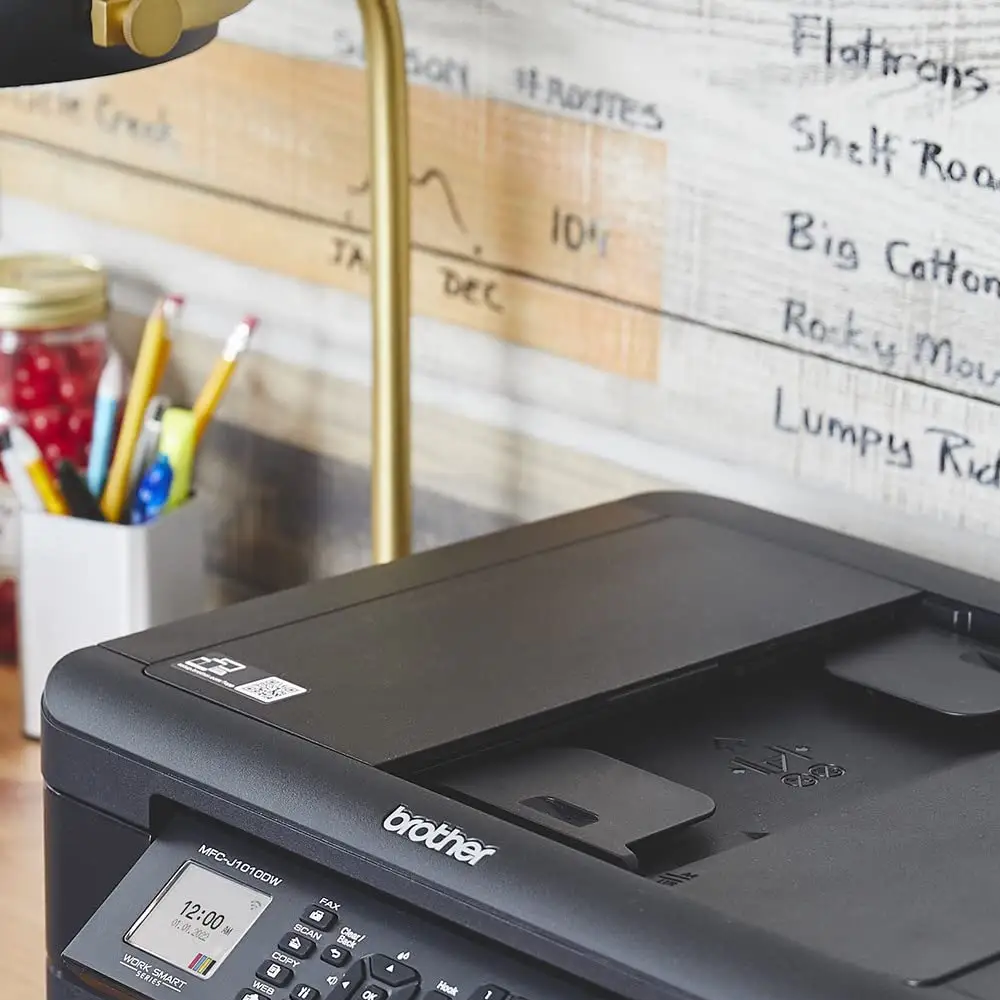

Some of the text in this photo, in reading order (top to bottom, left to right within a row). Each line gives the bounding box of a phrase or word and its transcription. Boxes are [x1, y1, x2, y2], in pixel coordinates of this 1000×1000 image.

[784, 211, 858, 270] Big
[438, 266, 506, 315] DEC
[773, 386, 913, 468] Lumpy
[383, 804, 498, 867] brother
[198, 844, 283, 887] MFC-J1010DW
[180, 900, 225, 930] 12:00
[318, 896, 342, 912] FAX
[293, 923, 323, 941] SCAN
[336, 935, 357, 950] Back
[122, 953, 188, 989] WORK SMART
[271, 951, 301, 968] COPY
[135, 970, 163, 988] SERIES
[251, 979, 276, 996] WEB
